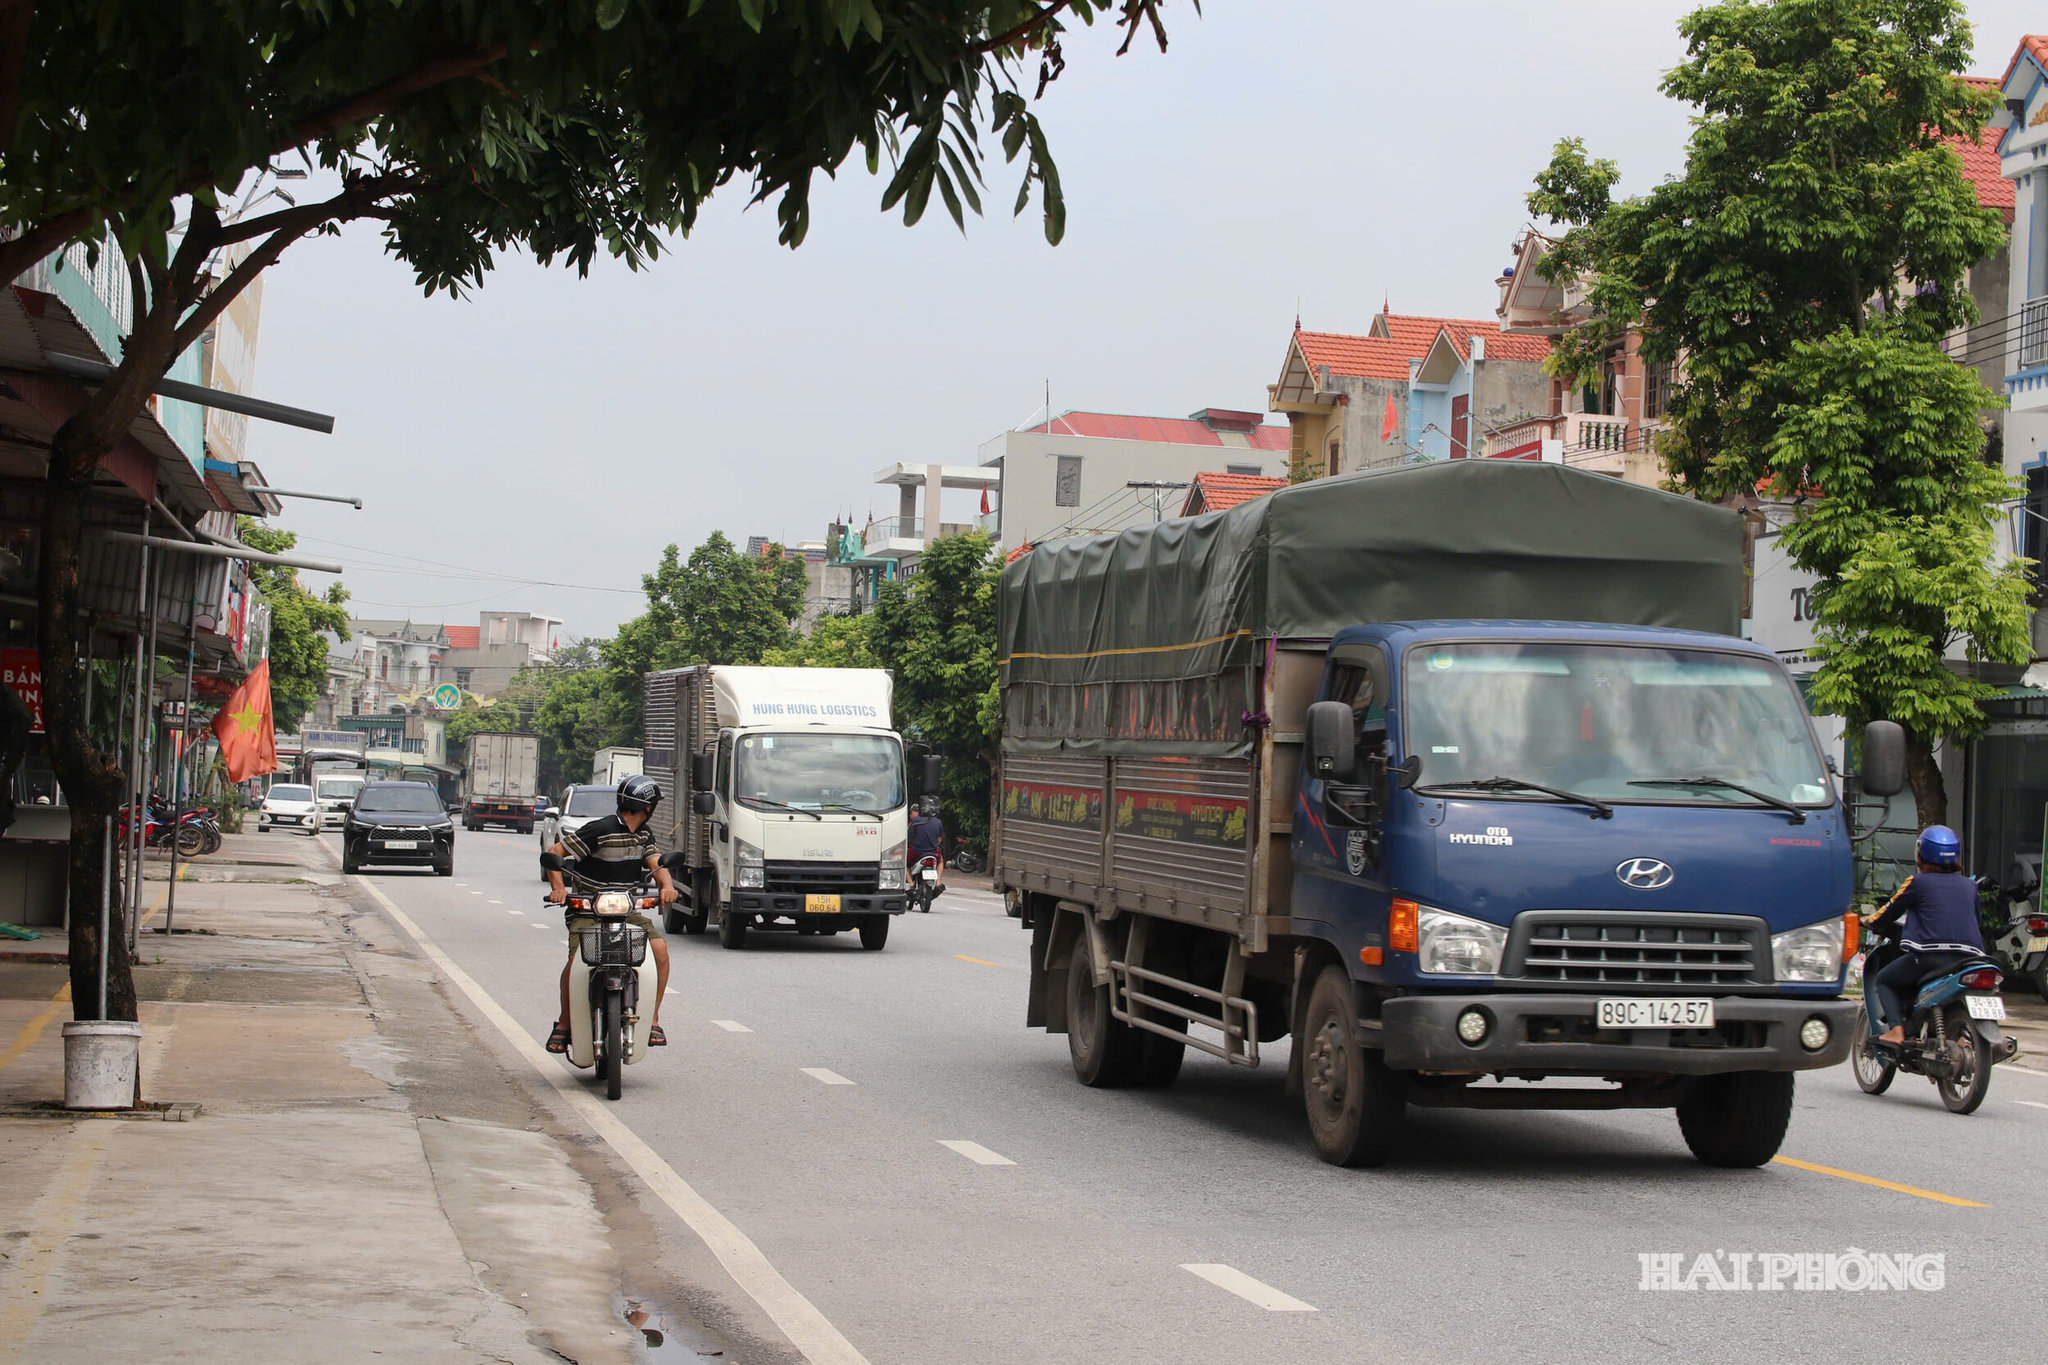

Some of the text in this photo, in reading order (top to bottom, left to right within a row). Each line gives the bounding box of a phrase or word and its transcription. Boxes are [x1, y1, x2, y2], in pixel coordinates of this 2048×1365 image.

[3, 665, 42, 685] BÁN
[820, 704, 877, 718] LOGISTICS
[1487, 826, 1508, 836] OTO
[1450, 833, 1513, 846] HYUNDAI
[816, 896, 831, 904] 15H
